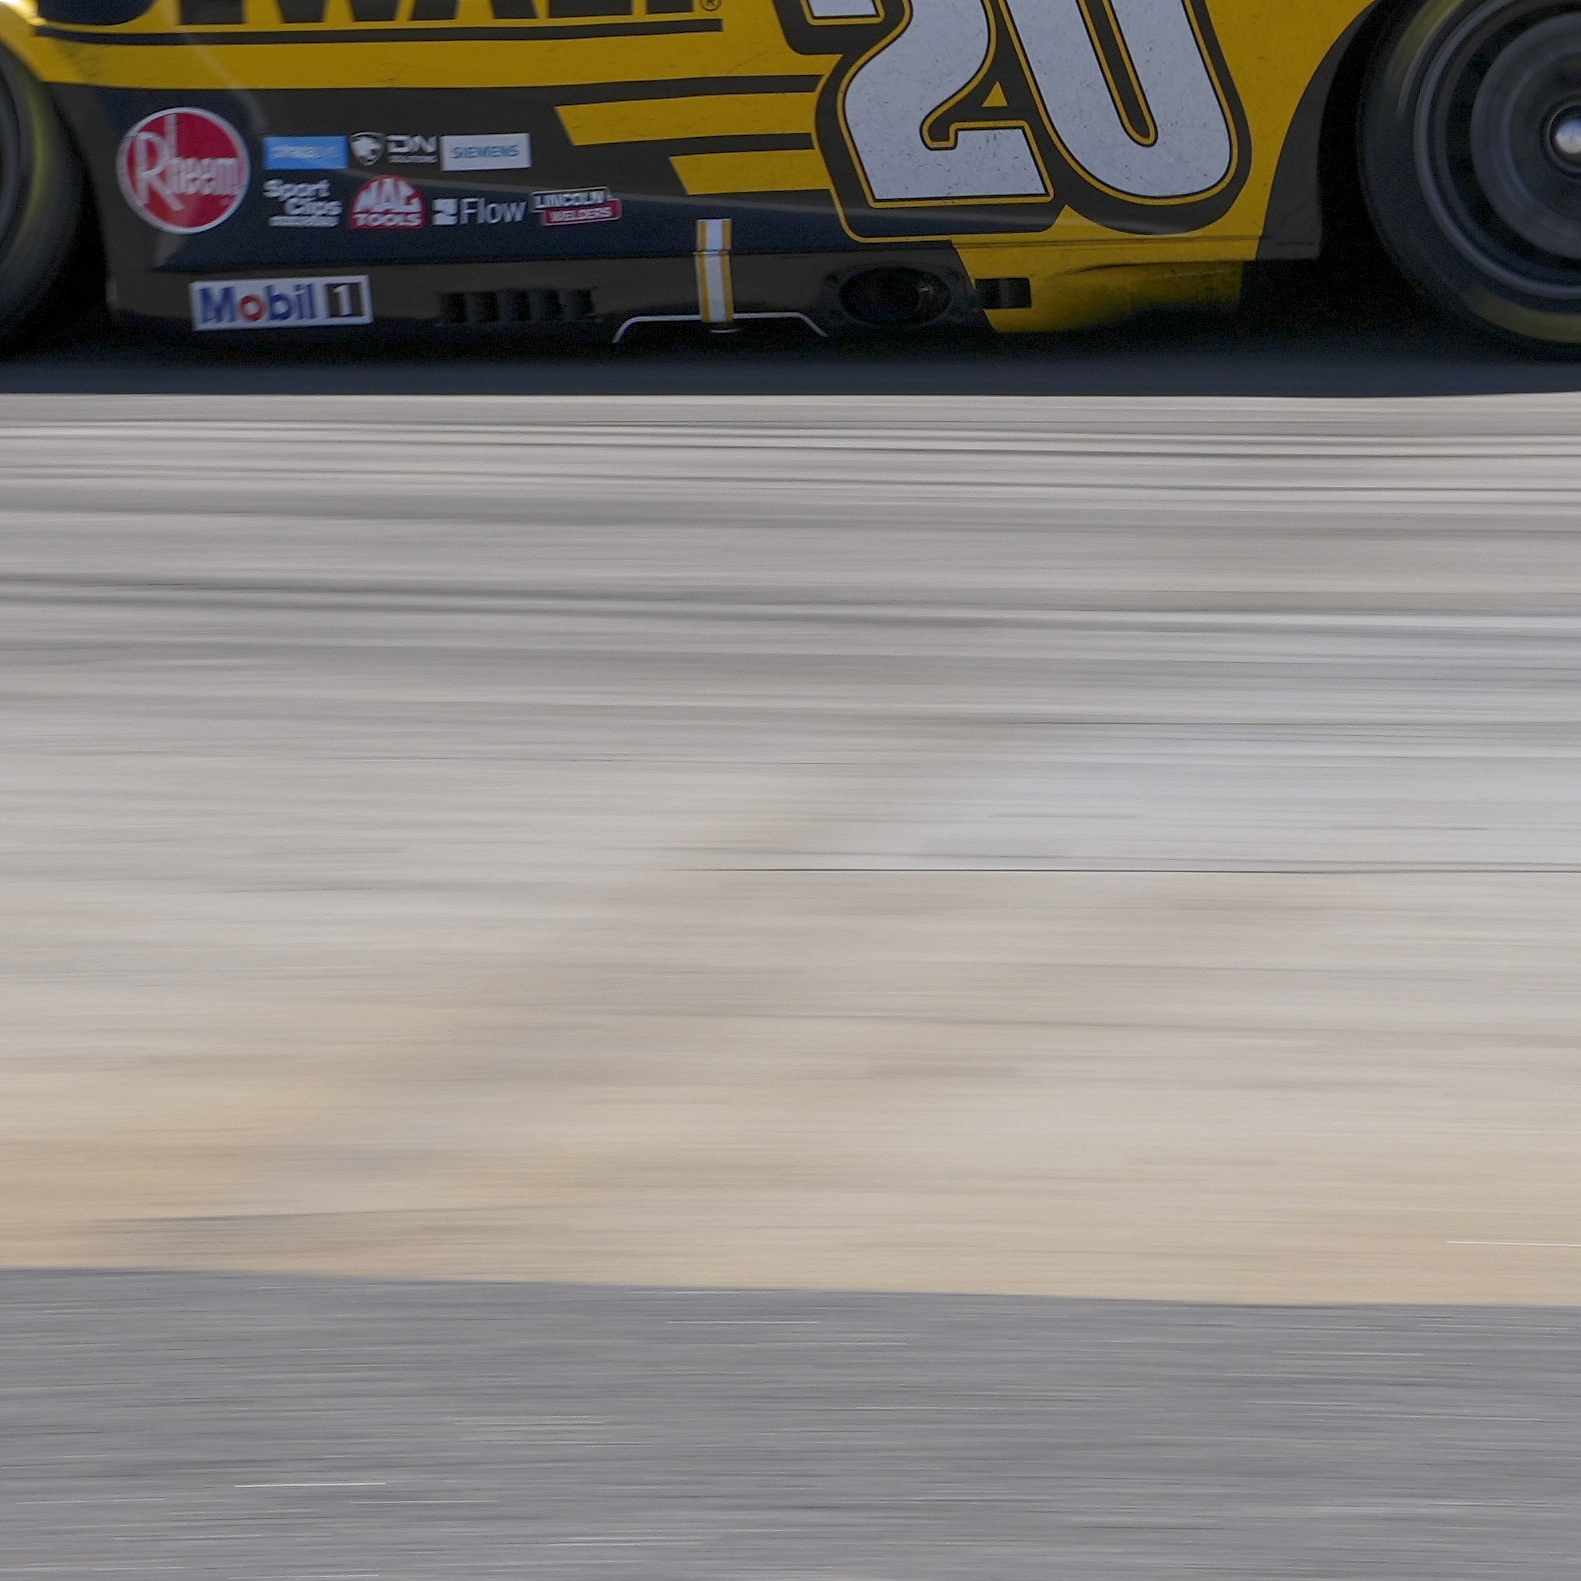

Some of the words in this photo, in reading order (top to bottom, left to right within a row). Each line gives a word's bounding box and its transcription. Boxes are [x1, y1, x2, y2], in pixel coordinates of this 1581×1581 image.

[451, 144, 519, 159] SIEMENS
[134, 113, 239, 212] Rheem
[263, 179, 331, 202] Sport
[357, 178, 421, 212] MAG
[534, 190, 606, 208] LINCOLN
[284, 197, 343, 216] Clips
[460, 197, 527, 224] Flow
[549, 207, 613, 222] WELDERS
[356, 213, 422, 227] TOOLS
[199, 284, 317, 323] Mobil
[333, 284, 352, 316] 1
